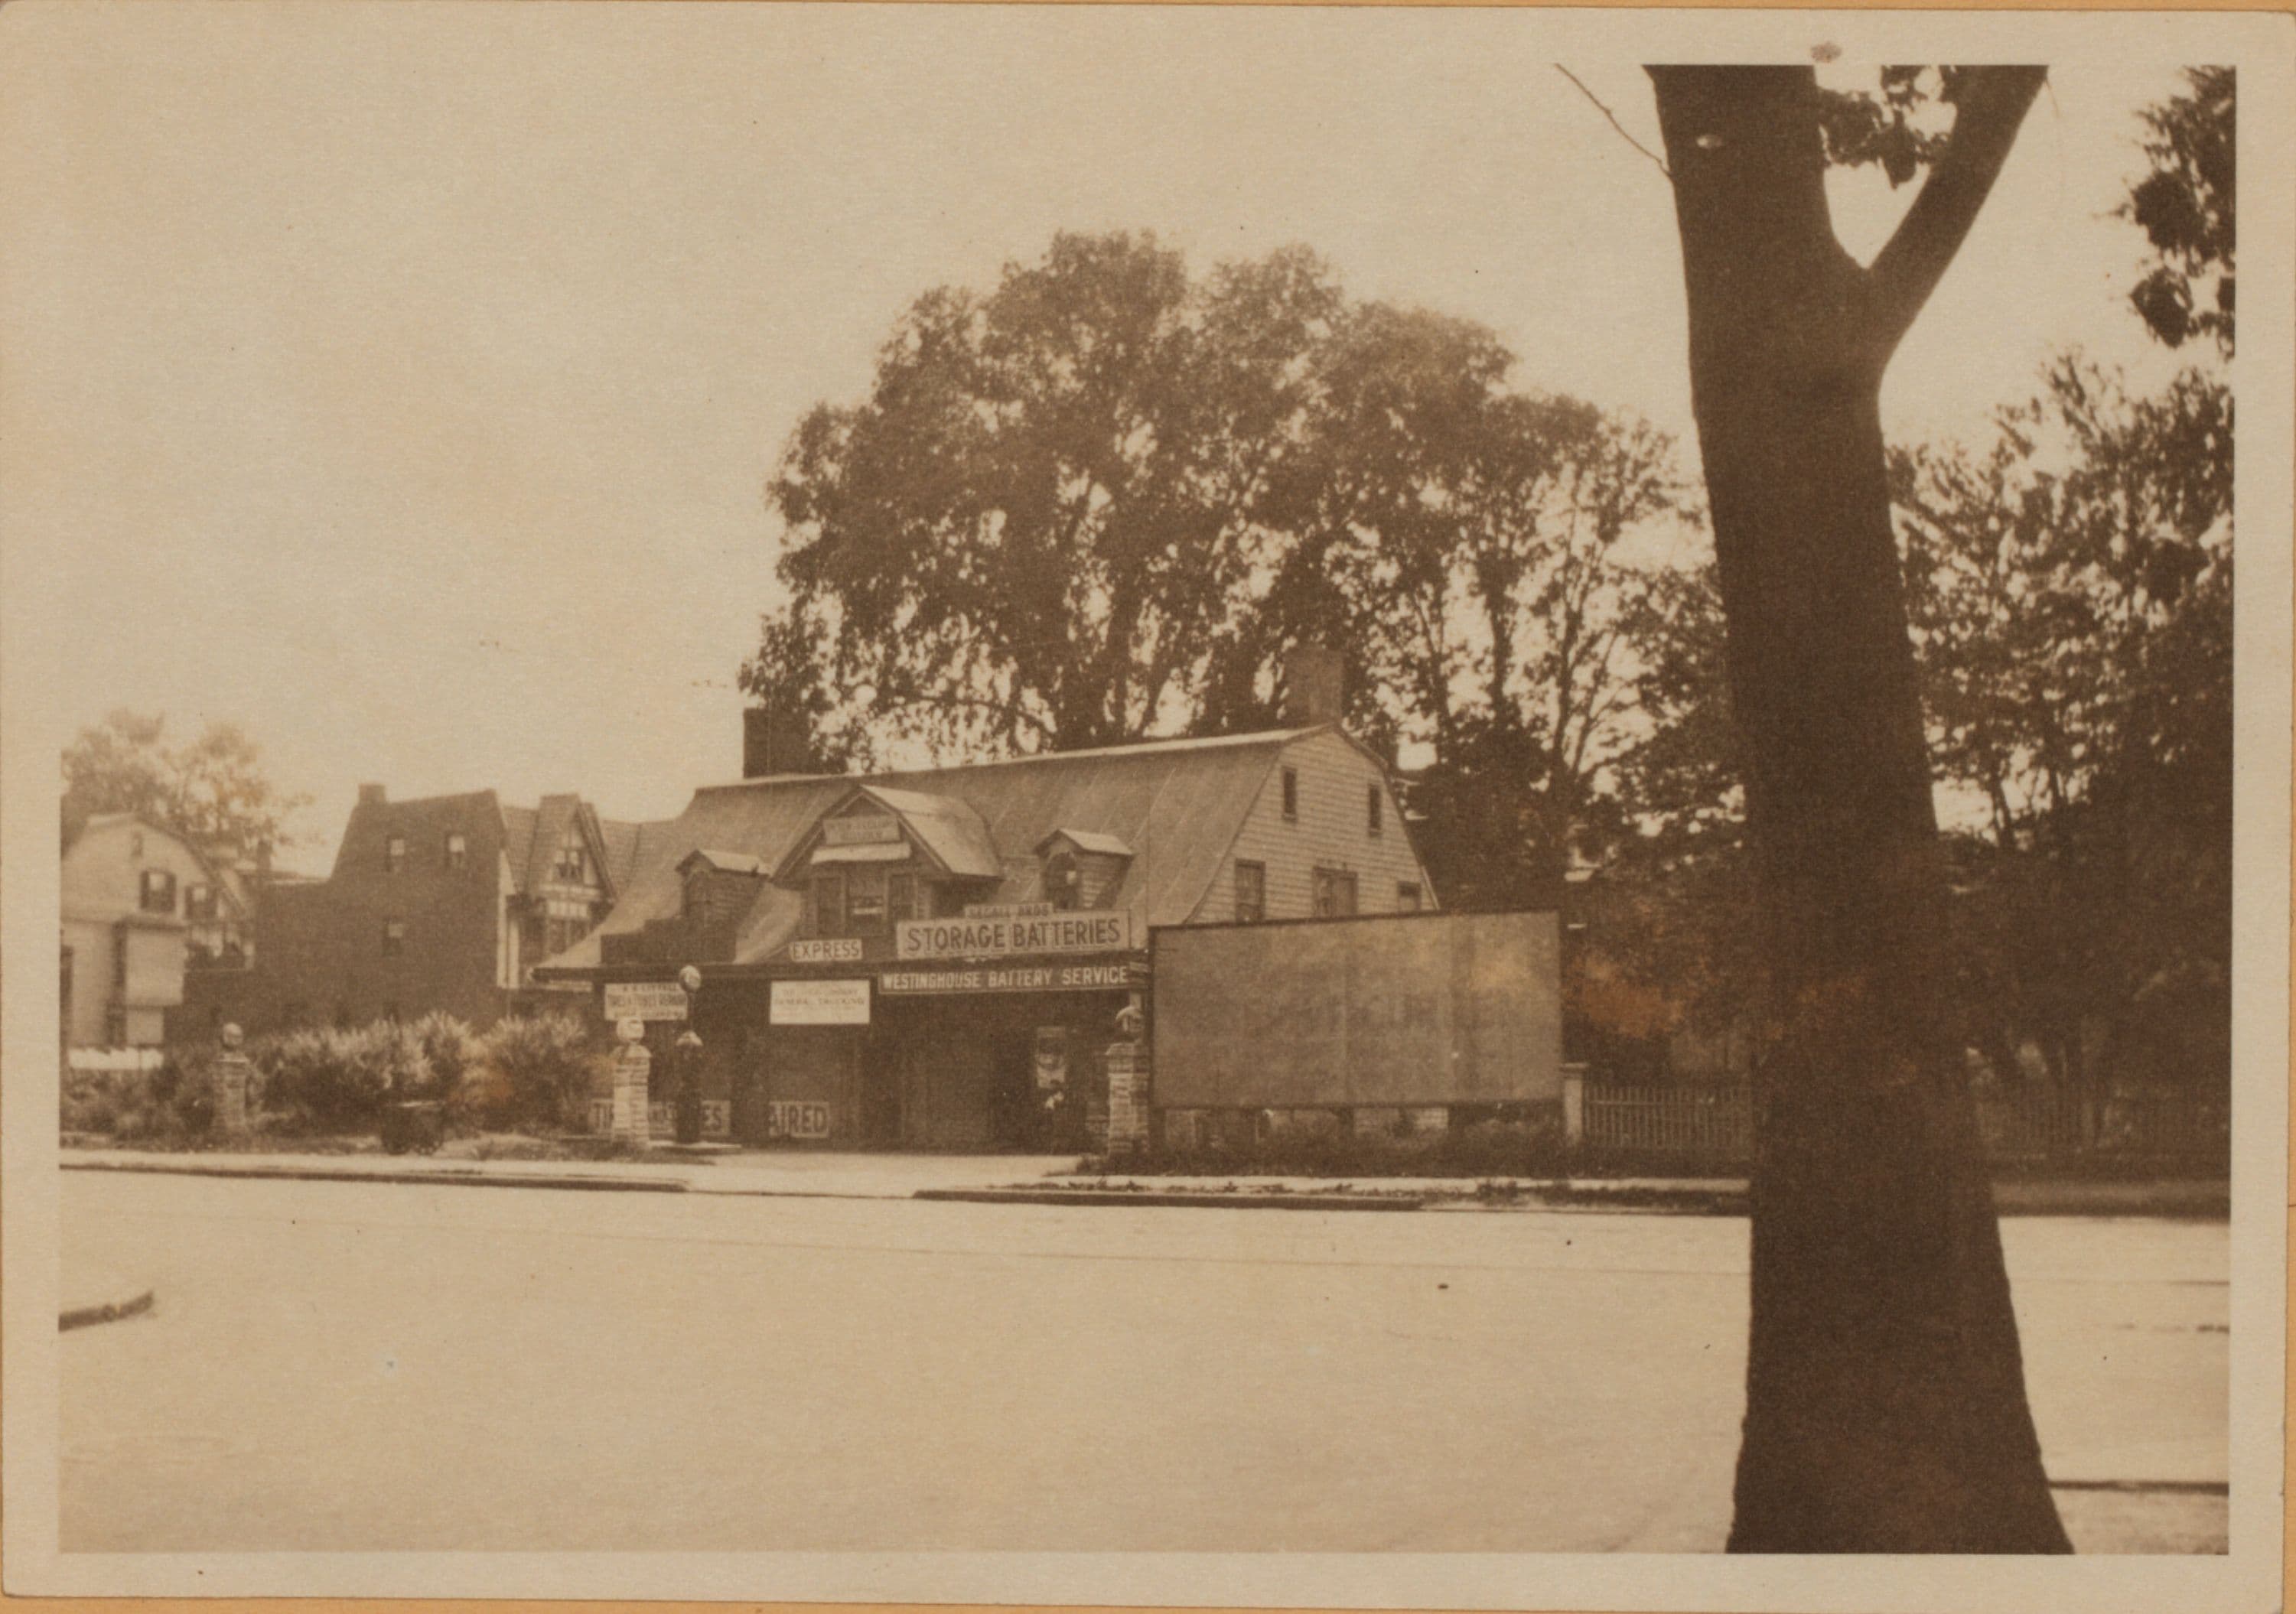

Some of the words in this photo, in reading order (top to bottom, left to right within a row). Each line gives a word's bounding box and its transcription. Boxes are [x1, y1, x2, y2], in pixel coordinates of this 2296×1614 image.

[907, 923, 1005, 952] STORAGE
[1013, 918, 1120, 949] BATTERIES
[793, 941, 859, 959] EXPRESS
[883, 971, 981, 991] WESTINGHOUSE
[988, 968, 1053, 988] BATTERY
[1062, 965, 1128, 985] SERVICE
